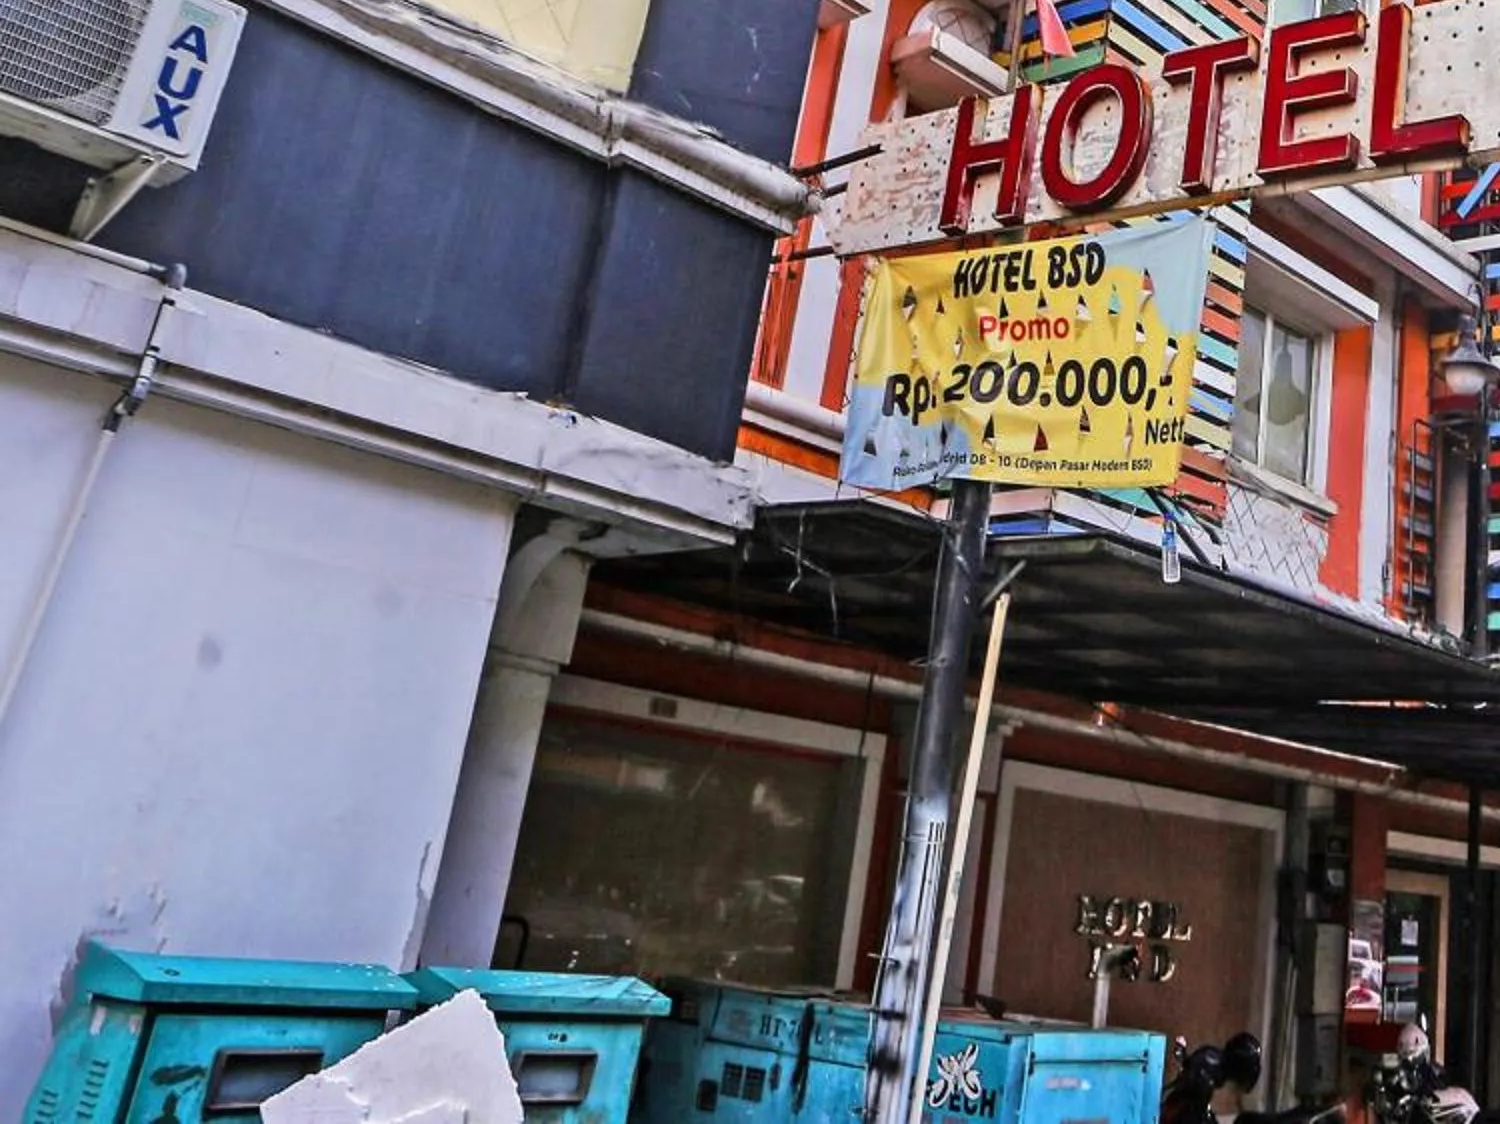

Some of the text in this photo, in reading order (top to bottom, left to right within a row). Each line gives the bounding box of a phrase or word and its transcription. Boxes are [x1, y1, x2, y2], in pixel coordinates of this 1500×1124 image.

[141, 25, 208, 140] AUX
[938, 2, 1470, 236] HOTEL
[954, 241, 1106, 299] HOTEL BSD
[978, 315, 1070, 343] Promo
[998, 455, 1011, 466] 10
